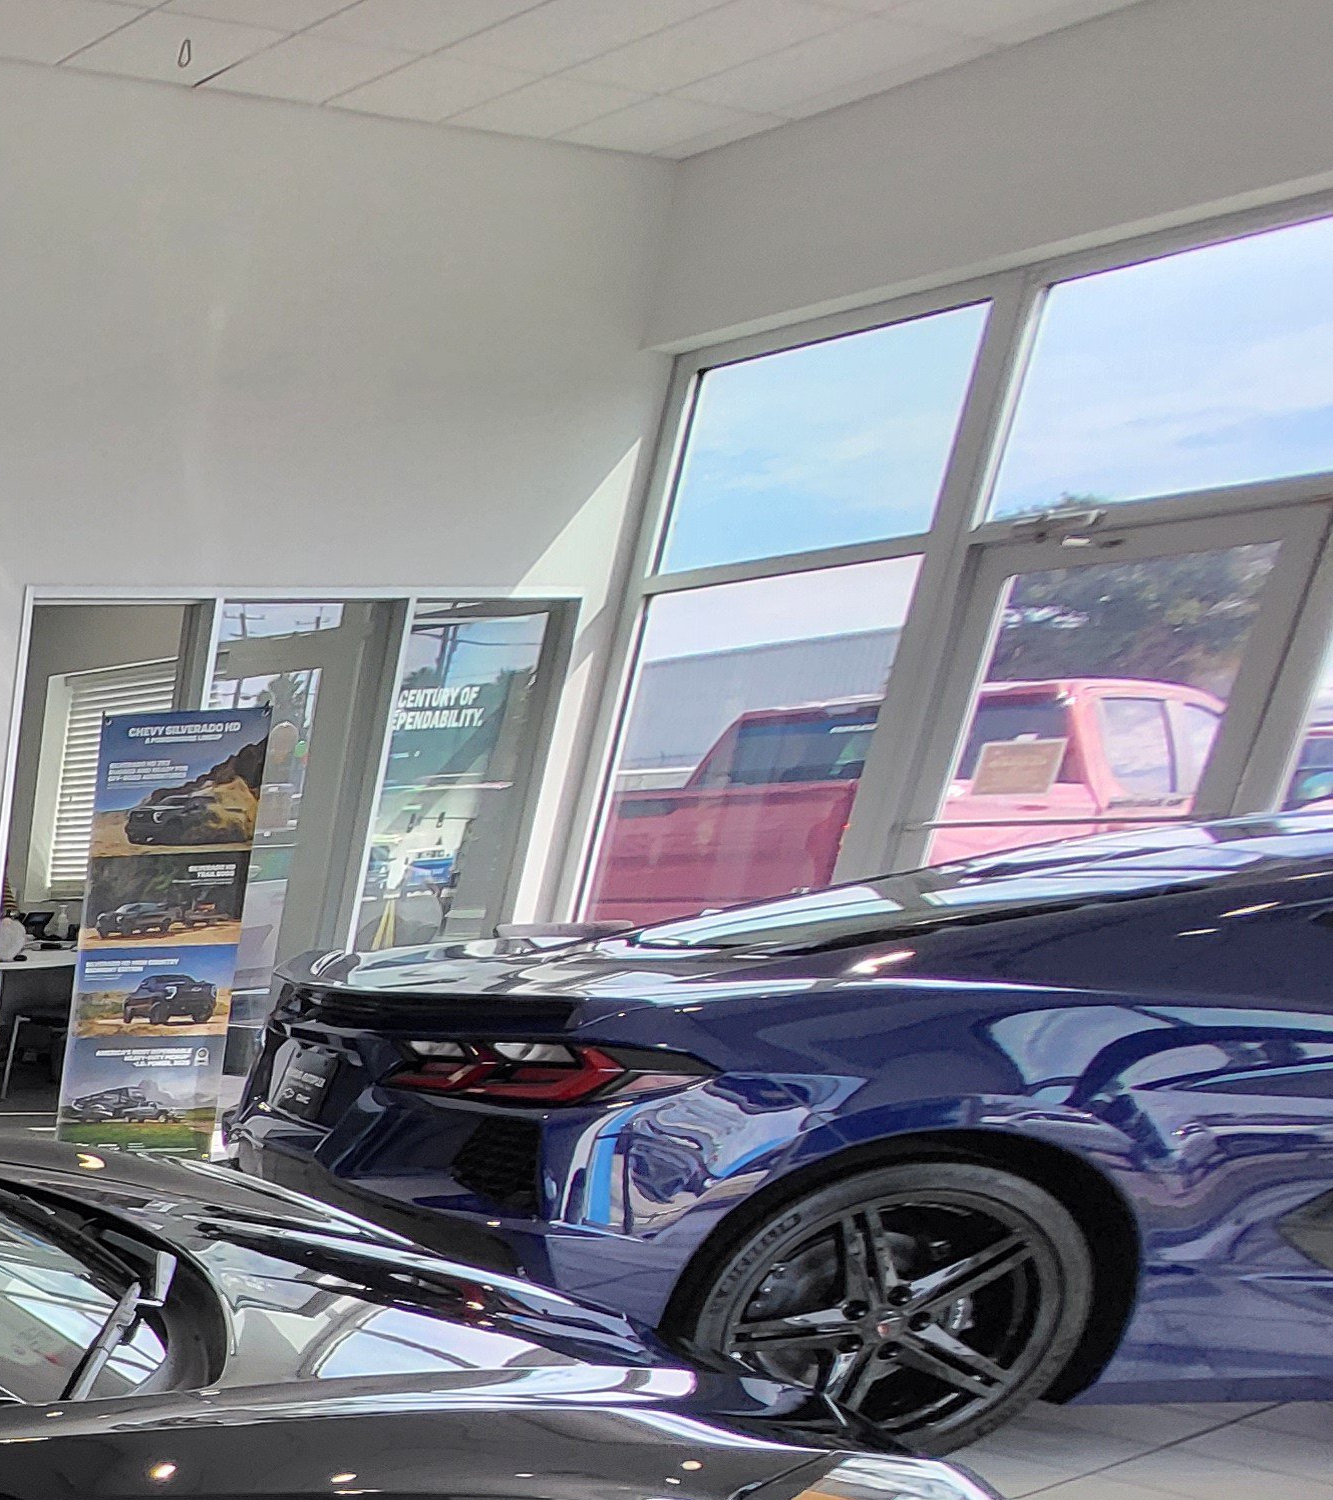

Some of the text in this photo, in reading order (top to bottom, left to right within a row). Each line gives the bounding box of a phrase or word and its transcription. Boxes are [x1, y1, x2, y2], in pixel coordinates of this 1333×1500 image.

[397, 686, 481, 708] CENTURY OF
[128, 722, 241, 738] CHEVY SILVERADO HD
